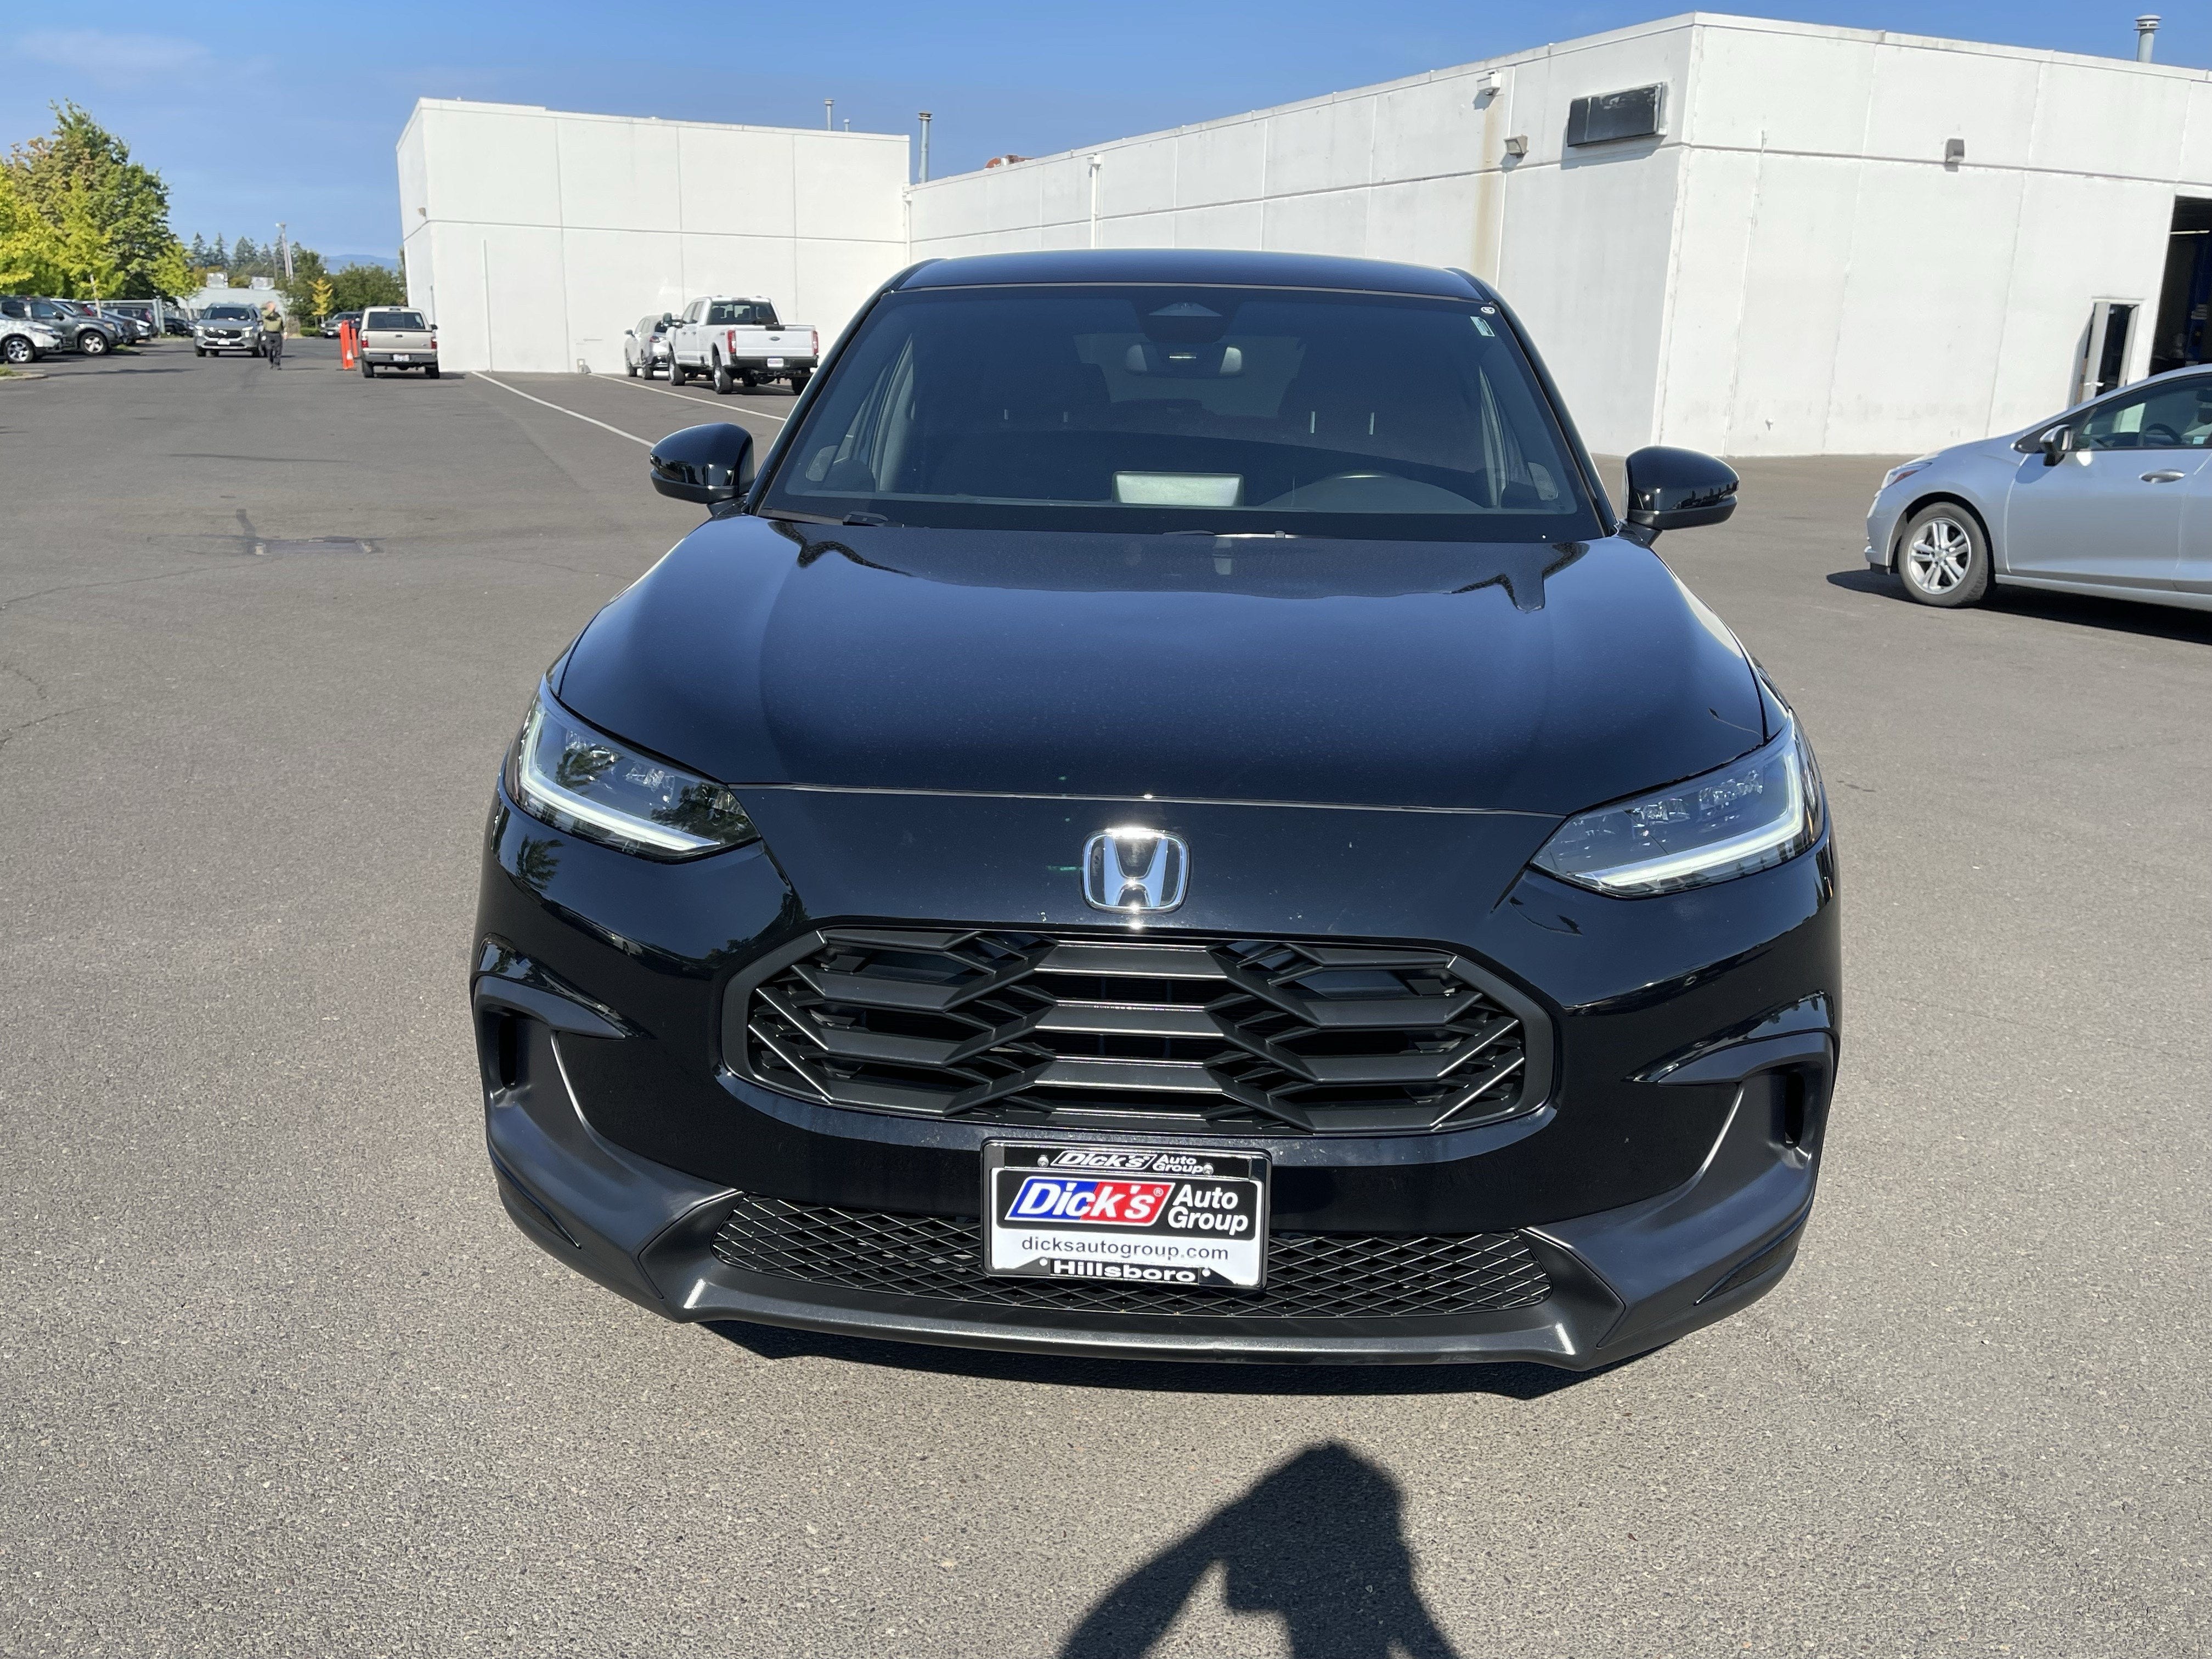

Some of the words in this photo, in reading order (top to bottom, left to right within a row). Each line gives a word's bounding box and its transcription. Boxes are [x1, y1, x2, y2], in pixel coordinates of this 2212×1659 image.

[1058, 1153, 1144, 1169] Dick's
[1156, 1154, 1197, 1165] Auto
[1153, 1163, 1204, 1174] Group
[1017, 1182, 1155, 1220] Dick's
[1172, 1185, 1239, 1210] Auto
[1167, 1207, 1249, 1236] Group
[1022, 1236, 1229, 1261] dicksautogroup.com
[1053, 1260, 1197, 1283] Hillsboro
